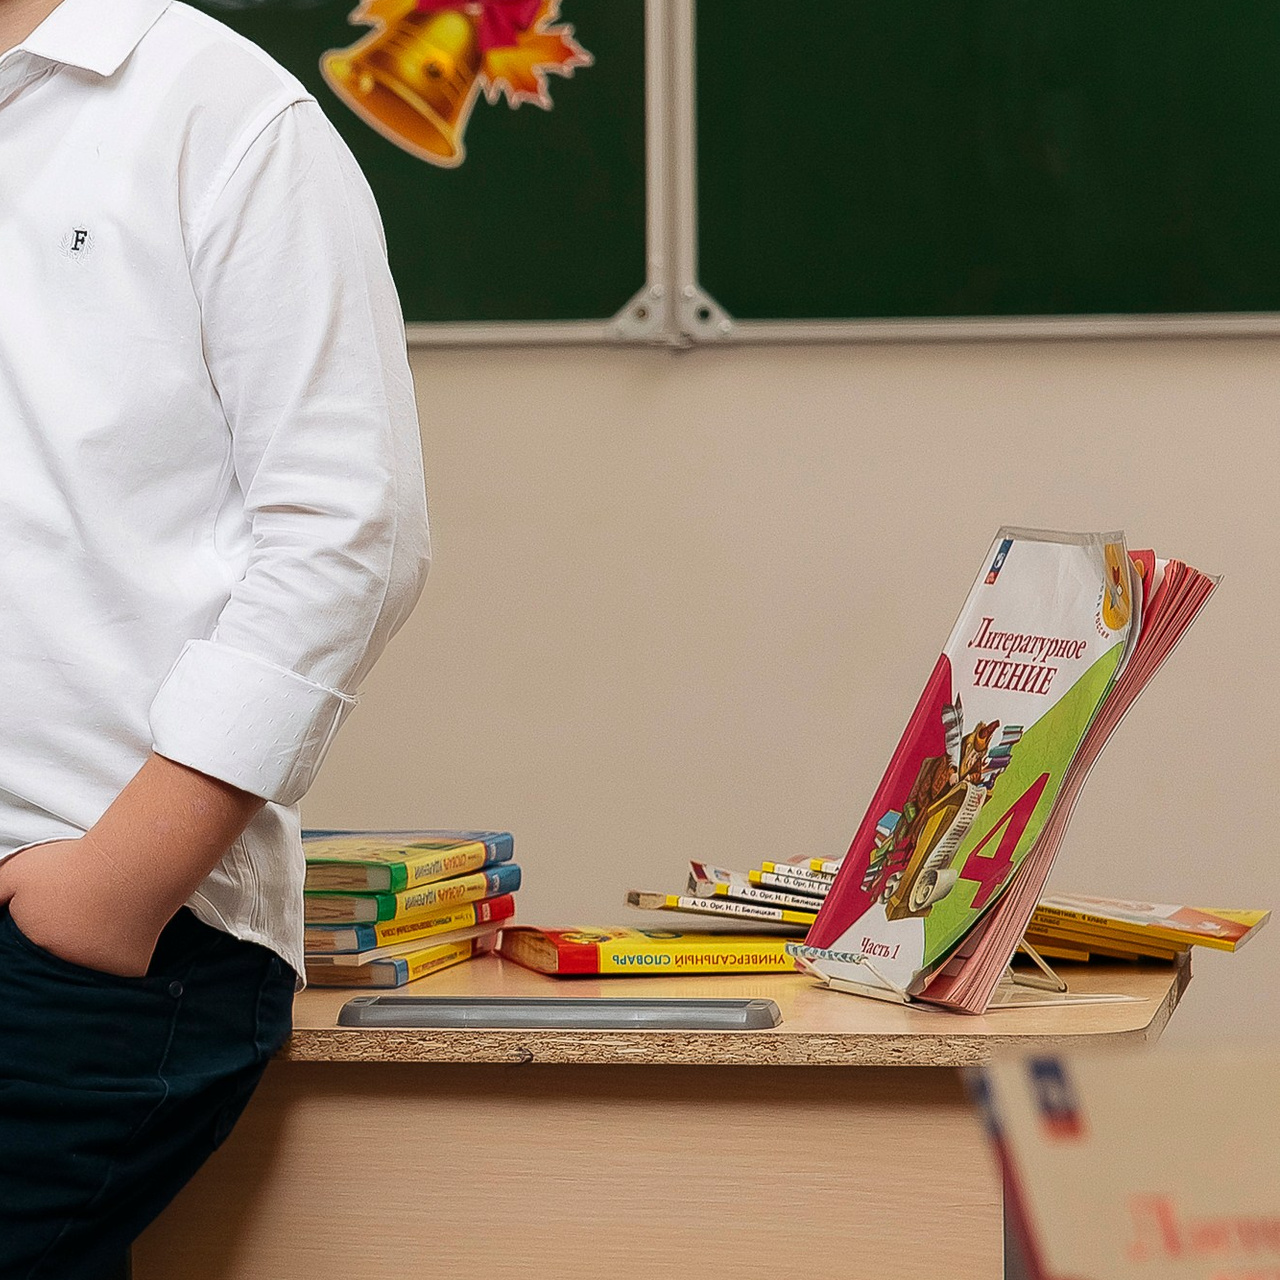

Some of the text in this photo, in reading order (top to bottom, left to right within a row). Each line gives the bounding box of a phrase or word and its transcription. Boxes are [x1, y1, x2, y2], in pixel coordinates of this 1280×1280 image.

[71, 230, 88, 251] F
[968, 618, 1087, 663] Литературное
[973, 659, 1058, 695] ЧТЕНИЕ
[959, 772, 1051, 909] 4
[691, 900, 700, 908] А.
[701, 901, 709, 909] О.
[861, 937, 901, 959] Часть 1
[612, 953, 786, 968] УНИВЕРСАЛЬНЫЙ СЛОВАРЬ
